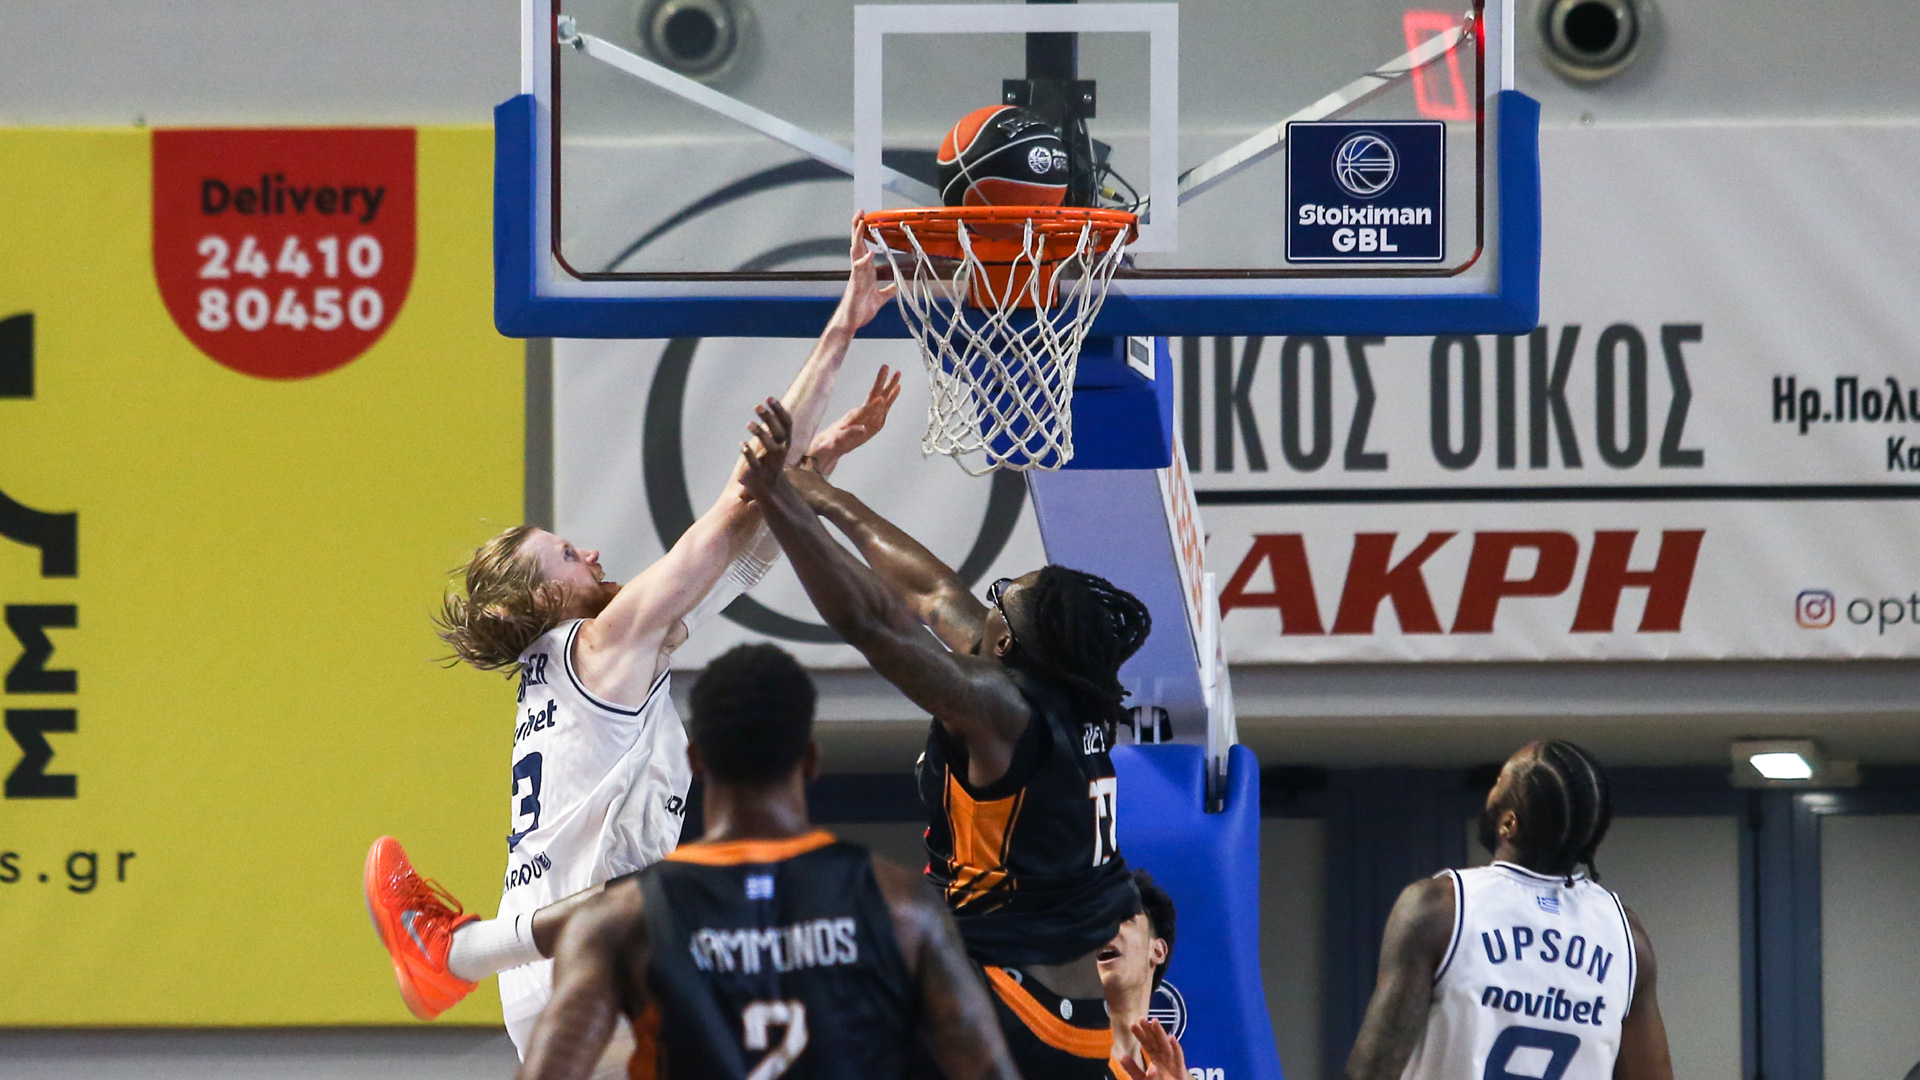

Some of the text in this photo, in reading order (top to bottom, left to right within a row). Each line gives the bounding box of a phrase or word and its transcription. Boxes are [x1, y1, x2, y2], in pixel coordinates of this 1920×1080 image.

[201, 173, 386, 223] Delivery
[1299, 204, 1432, 225] Stoiximan
[198, 236, 383, 278] 24410
[1332, 228, 1398, 252] GBL
[198, 288, 384, 331] 80450
[1181, 323, 1704, 473] ΙΚΟΣ ΟΙΚΟΣ
[1217, 530, 1706, 636] ΑΚΡΗ
[1482, 926, 1613, 985] UPSON
[1481, 986, 1606, 1026] novibet
